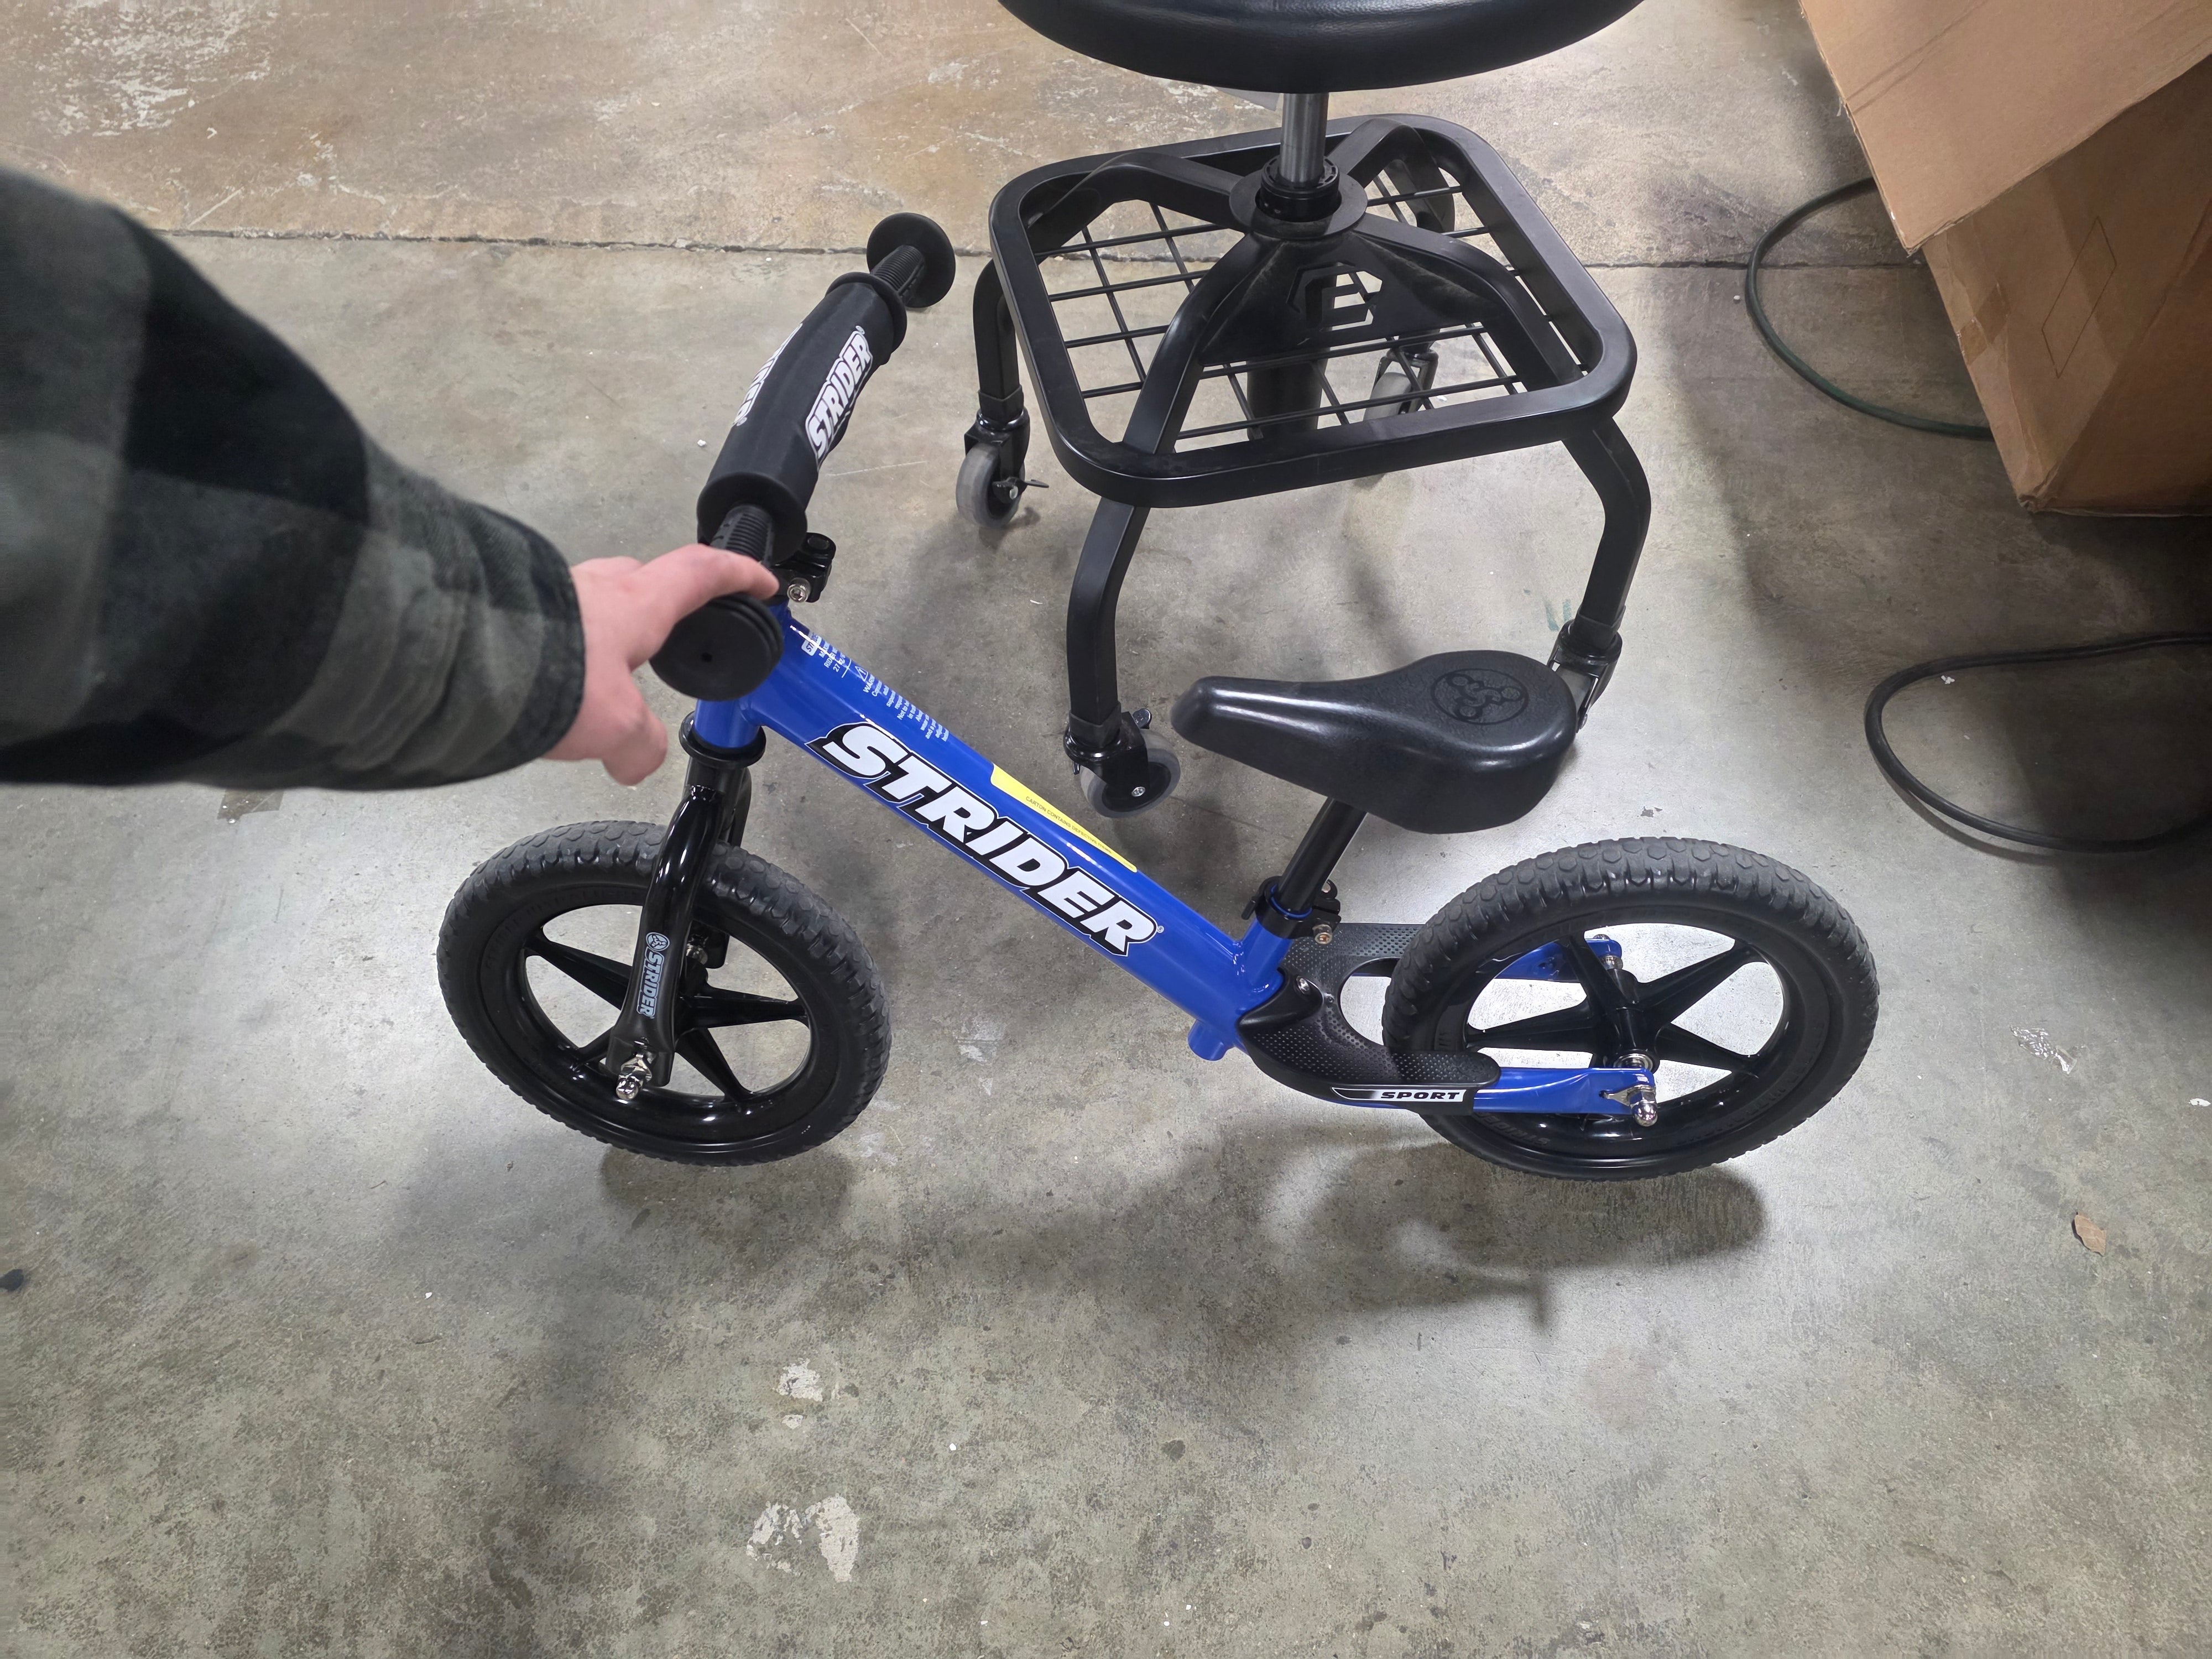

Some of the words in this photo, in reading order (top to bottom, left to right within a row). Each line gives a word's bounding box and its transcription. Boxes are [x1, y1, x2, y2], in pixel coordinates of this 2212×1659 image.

[807, 332, 872, 457] STRIDER
[833, 664, 841, 672] 27
[822, 725, 1155, 953] STRIDER
[1025, 796, 1047, 812] CARTON
[1047, 809, 1071, 828] CONTAINS
[1072, 825, 1097, 844] DEFECTIVE
[638, 952, 663, 1017] STRIDER
[1380, 1092, 1459, 1100] SPORT
